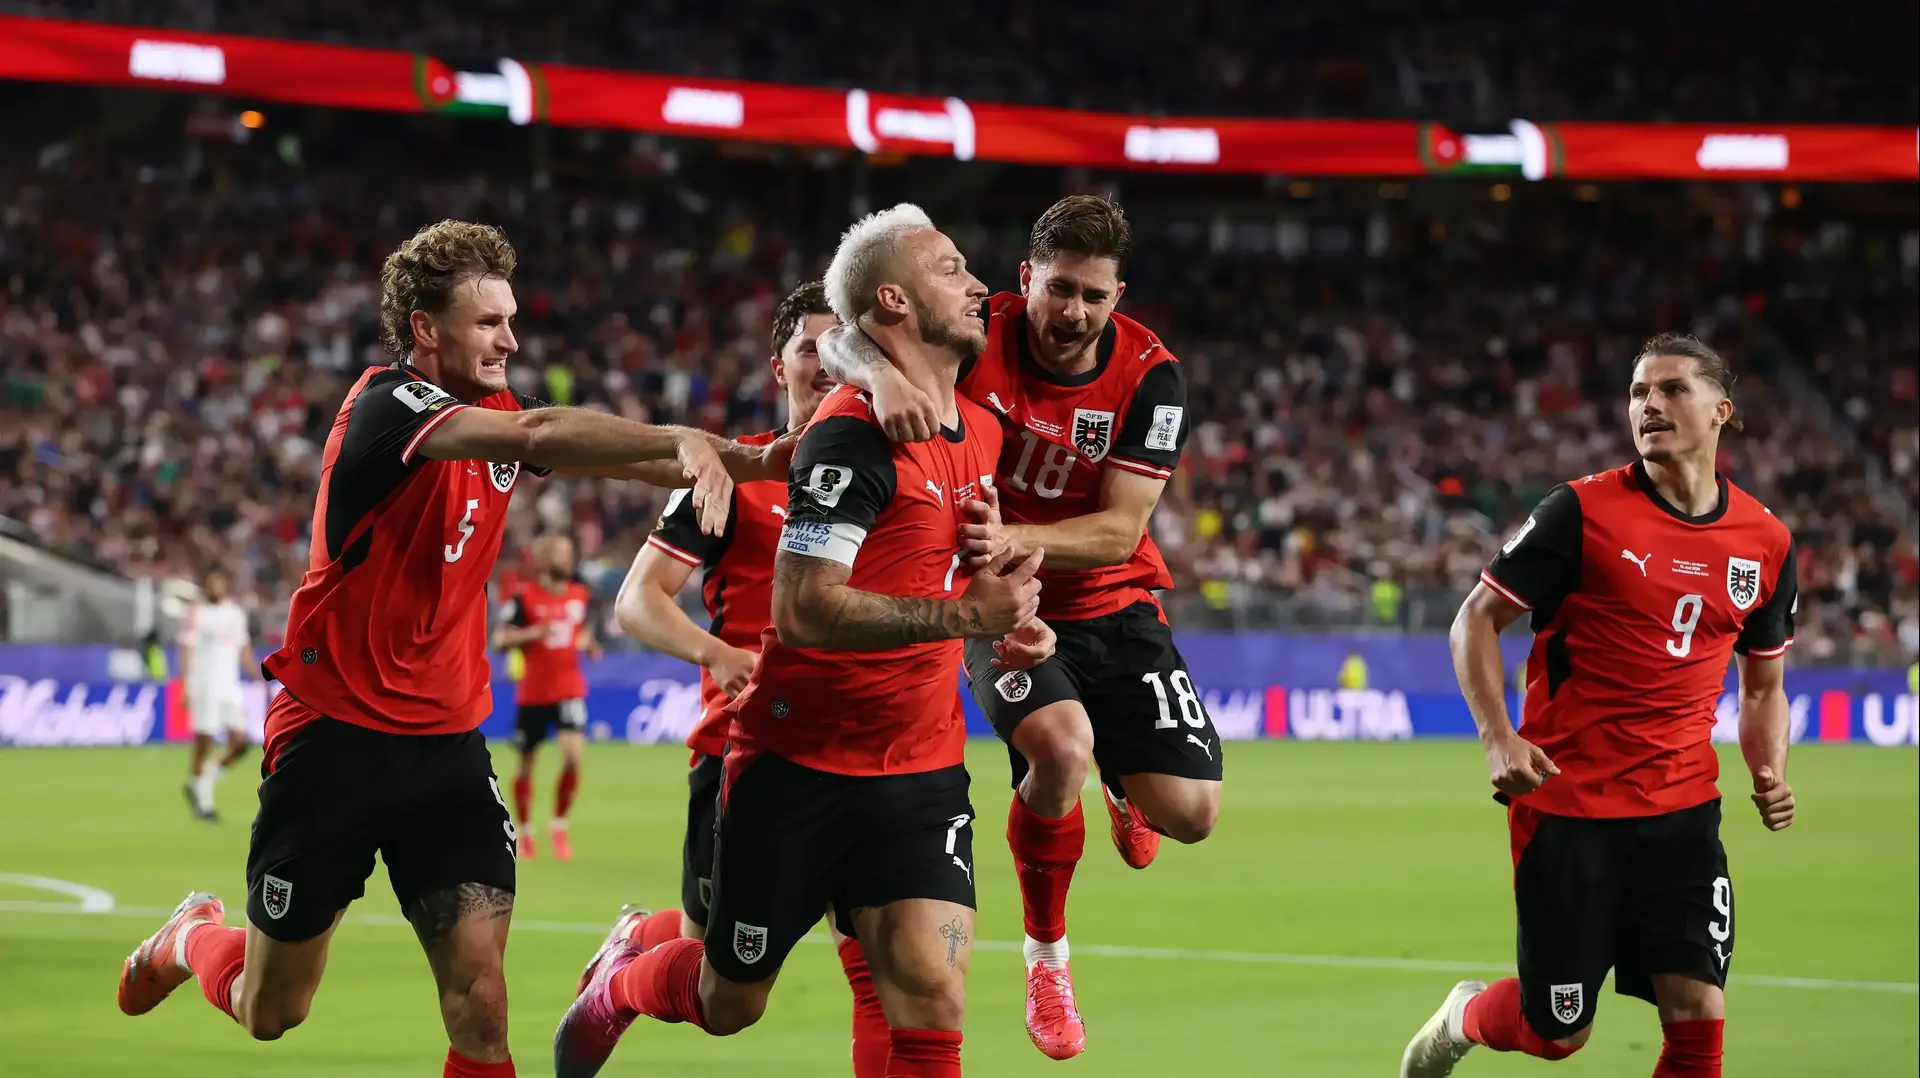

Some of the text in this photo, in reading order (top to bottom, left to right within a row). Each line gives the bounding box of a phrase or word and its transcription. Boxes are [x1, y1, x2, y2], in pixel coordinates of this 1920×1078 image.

[1004, 429, 1078, 500] 18
[810, 491, 828, 502] 2026
[444, 498, 480, 563] 5
[788, 541, 807, 551] FIFA
[794, 531, 830, 547] World
[1665, 593, 1703, 658] 9
[1142, 669, 1206, 730] 18
[1289, 688, 1413, 740] ULTRA
[1707, 876, 1730, 943] 9
